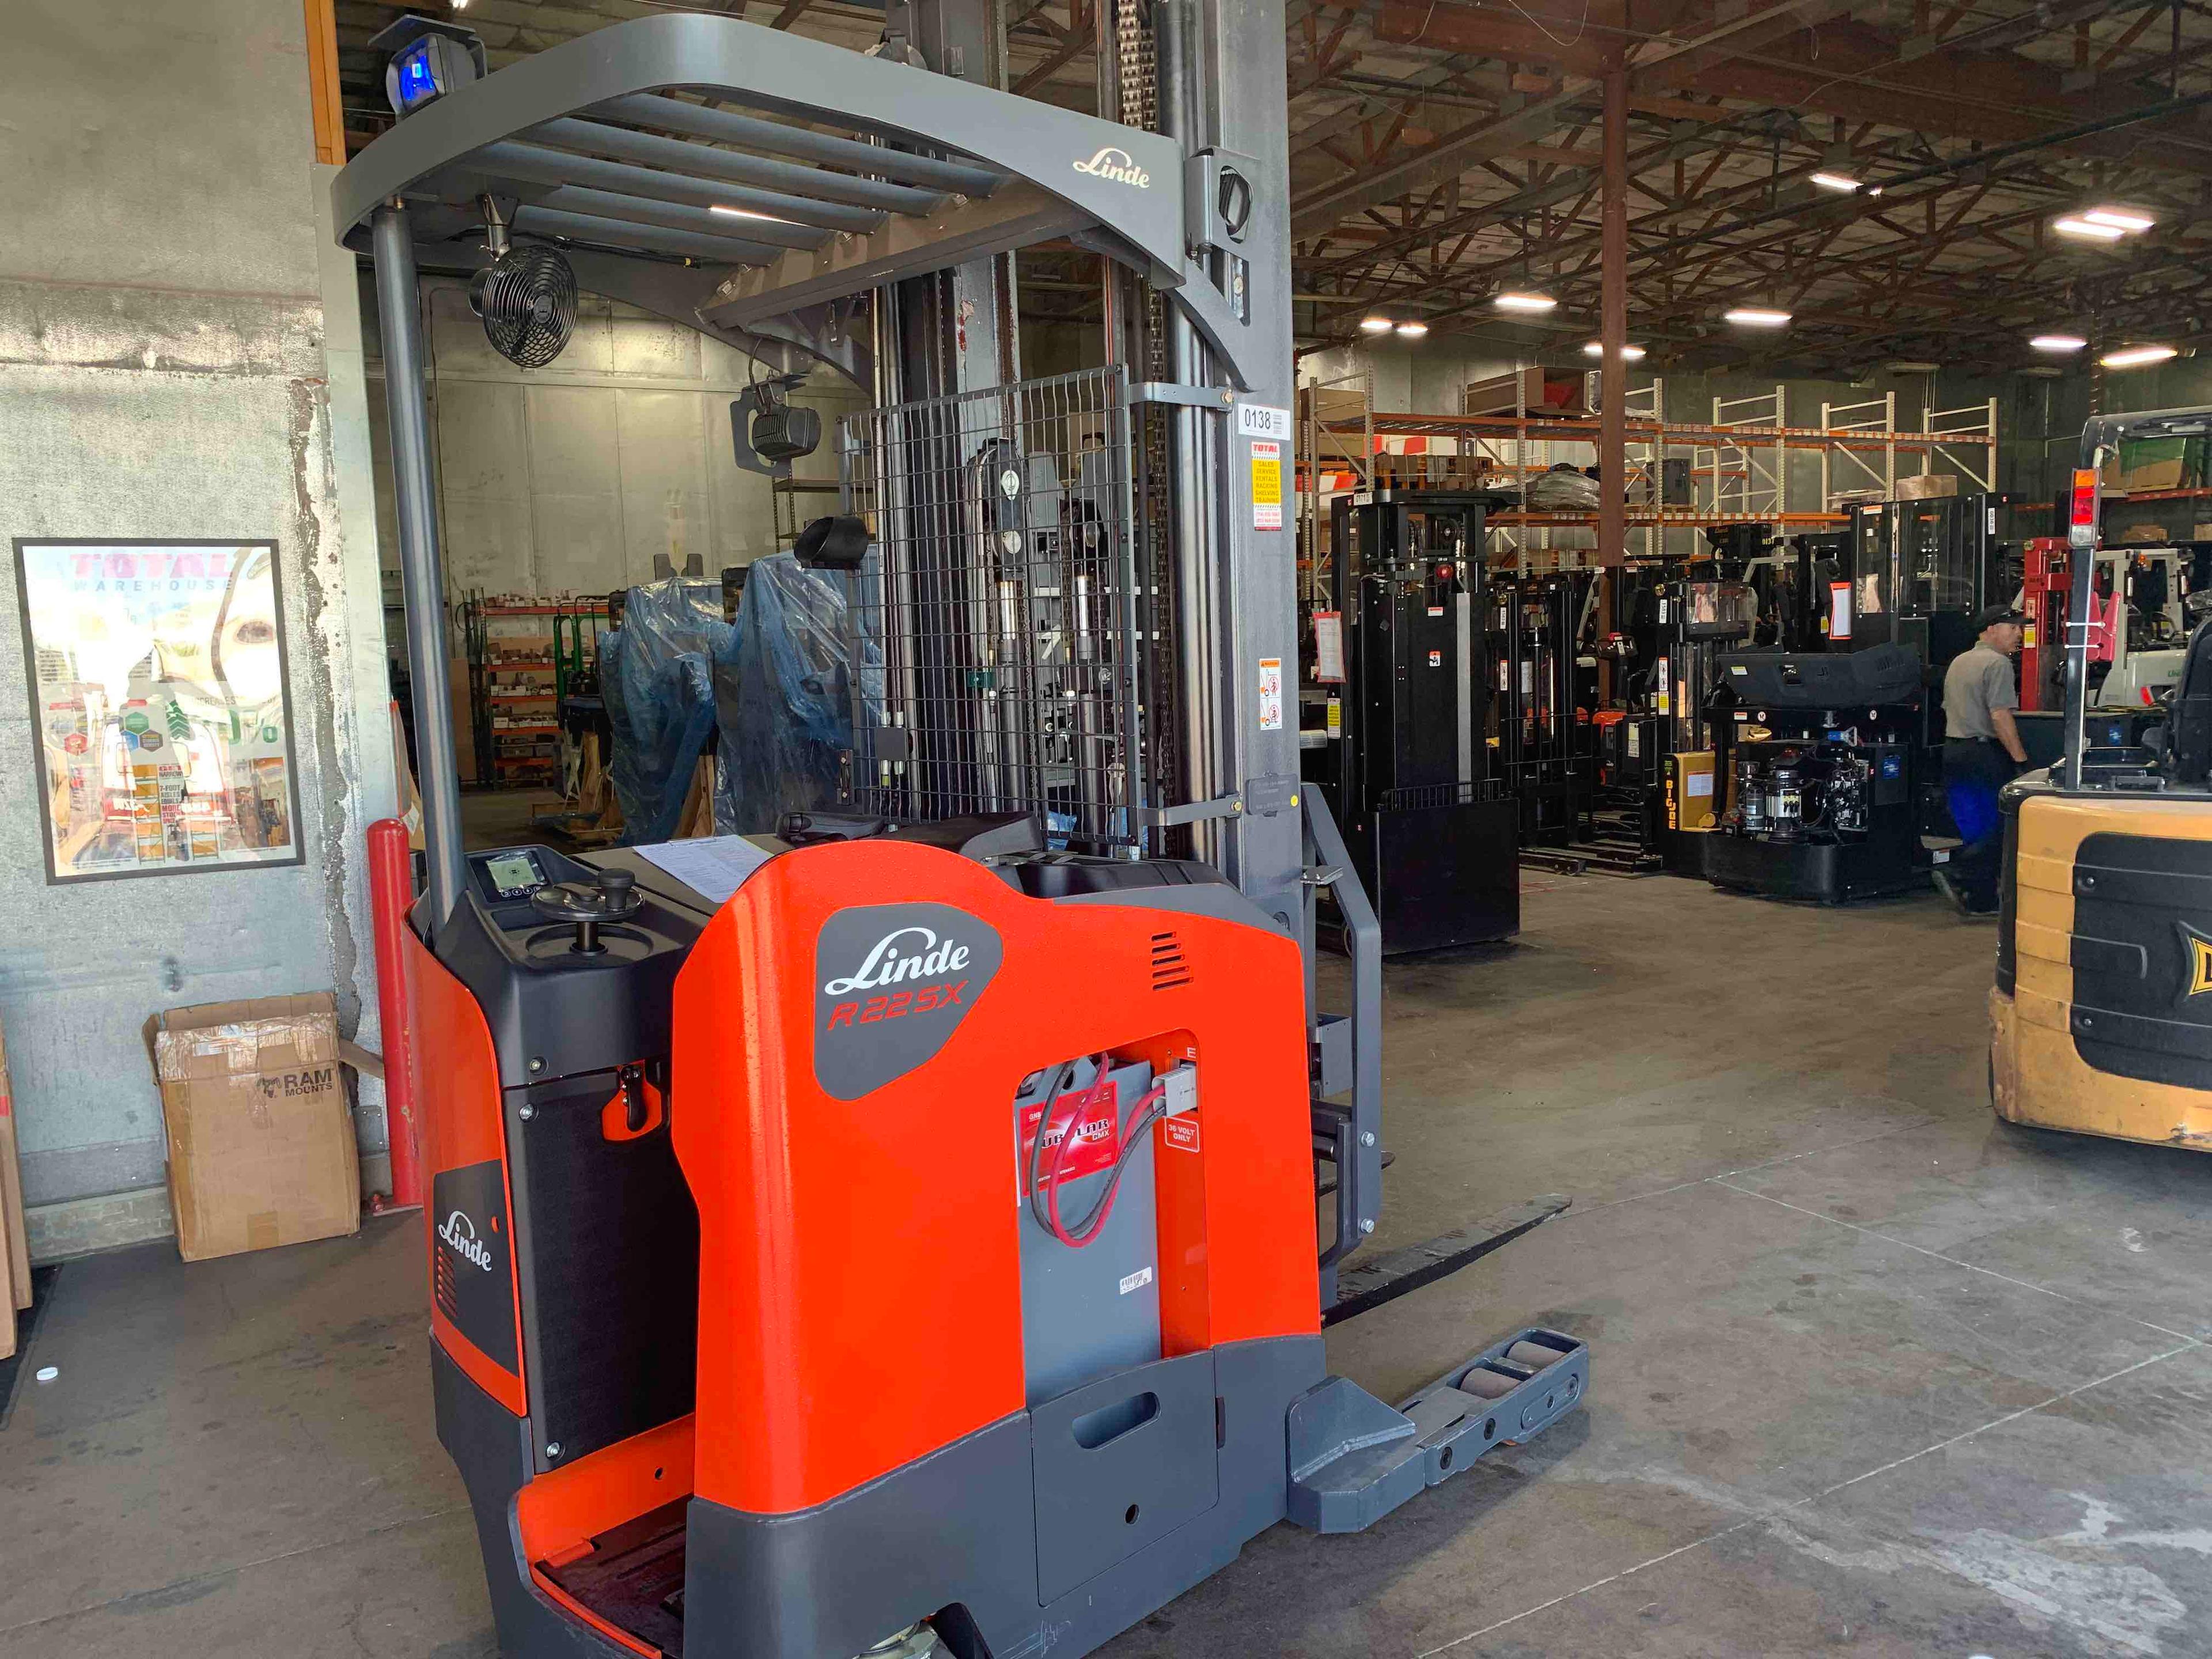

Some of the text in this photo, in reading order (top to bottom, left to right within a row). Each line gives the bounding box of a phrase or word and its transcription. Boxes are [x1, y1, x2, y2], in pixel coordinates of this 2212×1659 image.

[1073, 147, 1149, 189] Linde
[1245, 408, 1271, 429] 0138
[1253, 444, 1277, 453] TOTAL
[70, 554, 232, 578] TOTAL
[825, 927, 969, 995] Linde
[284, 1069, 332, 1089] RAM
[286, 1082, 332, 1096] MOUNTS
[1168, 1124, 1195, 1136] 36 VOLT
[1173, 1132, 1191, 1142] ONLY
[438, 1211, 492, 1271] Linde
